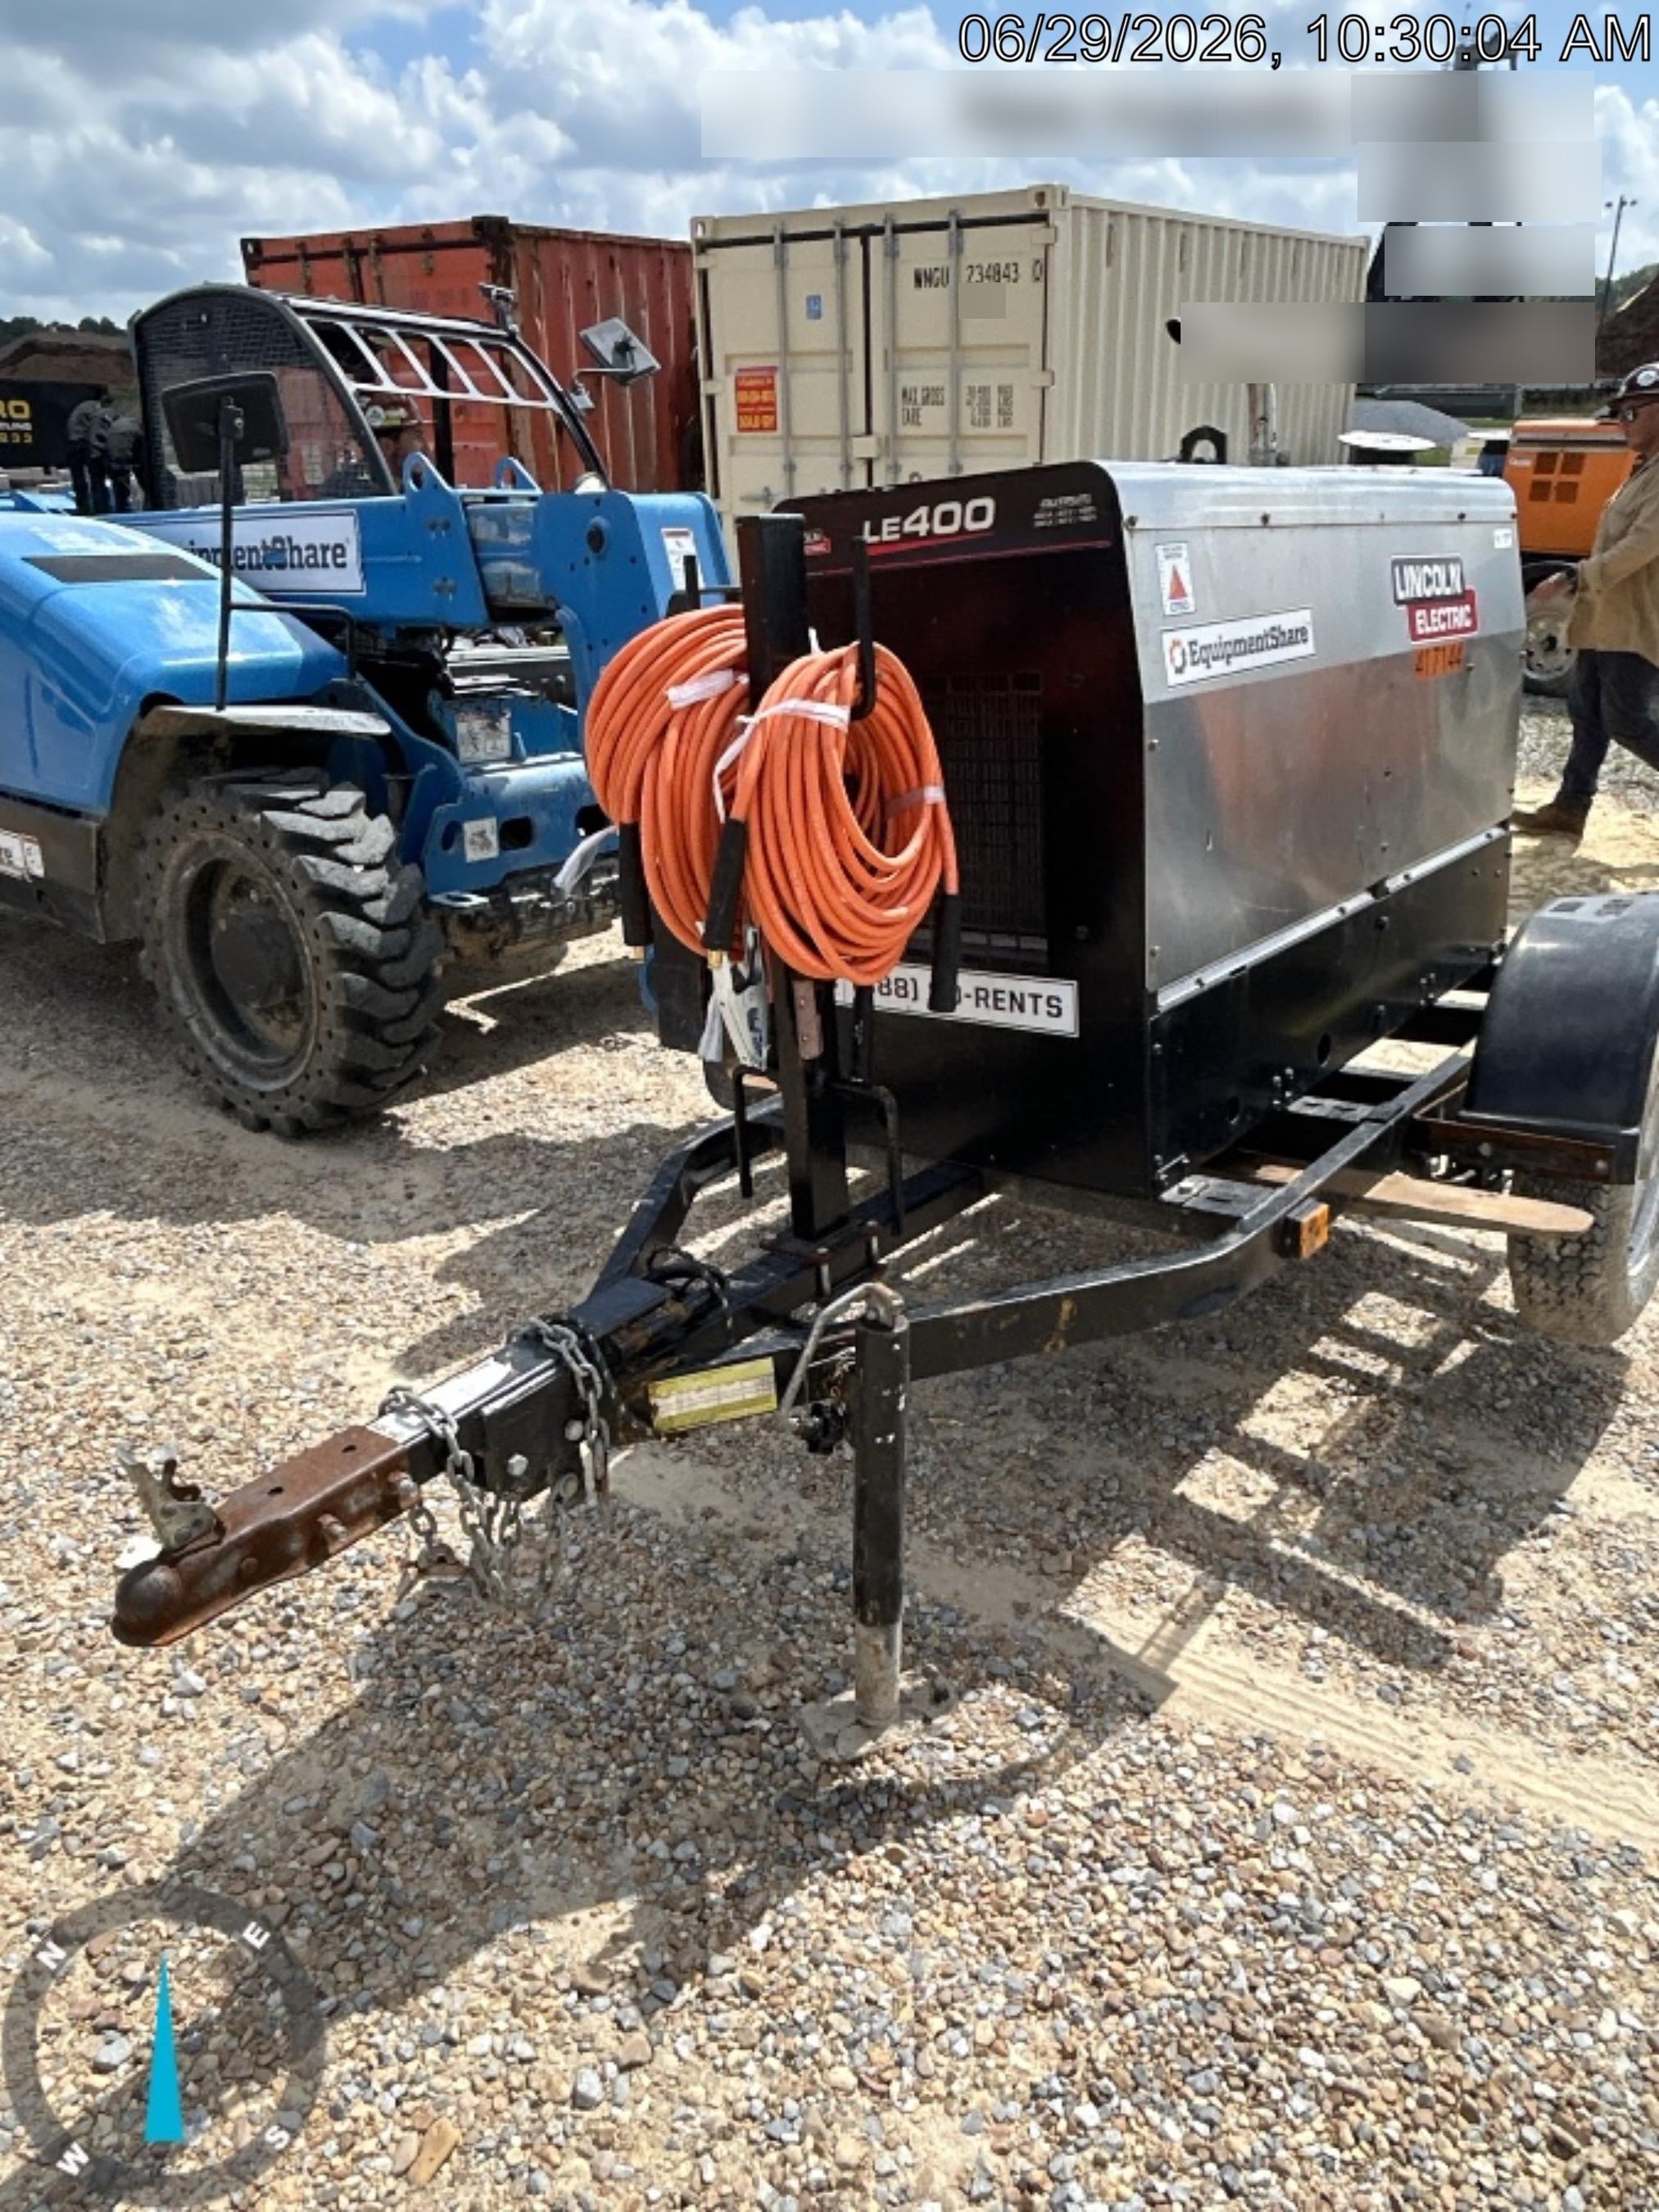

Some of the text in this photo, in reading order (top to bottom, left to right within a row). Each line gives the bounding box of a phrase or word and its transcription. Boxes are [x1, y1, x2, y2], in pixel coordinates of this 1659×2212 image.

[862, 497, 995, 544] LE400
[1394, 562, 1464, 601] LINCOLN
[1415, 604, 1473, 635] ELECTRIC
[1188, 623, 1308, 669] EquipmentShare
[878, 977, 1063, 1018] 88) -RENTS
